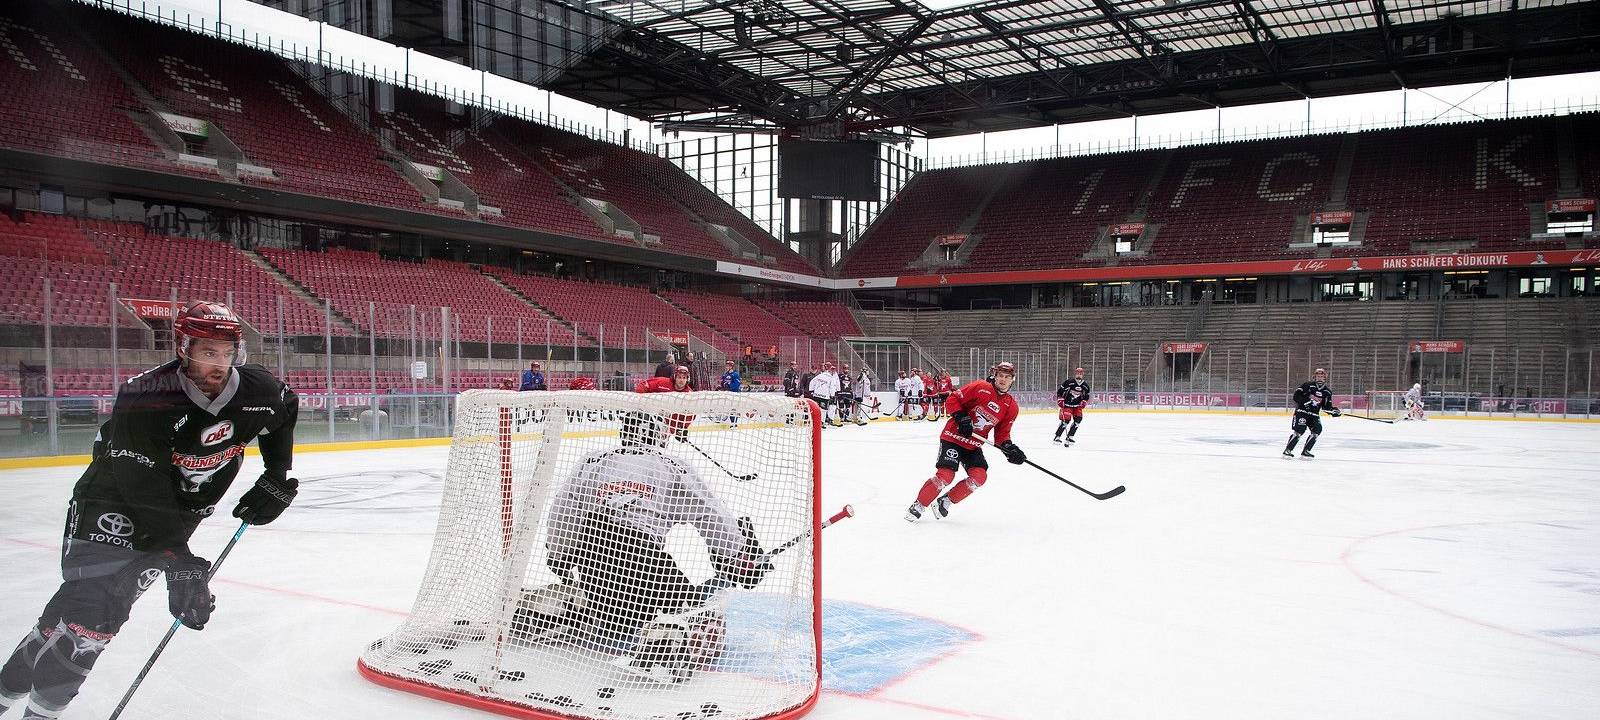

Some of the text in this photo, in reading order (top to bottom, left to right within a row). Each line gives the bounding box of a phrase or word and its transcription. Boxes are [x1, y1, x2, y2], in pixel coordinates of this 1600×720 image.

[1383, 254, 1509, 269] HANS SCHÄFER SÜDKURVE
[89, 533, 134, 551] TOYOTA
